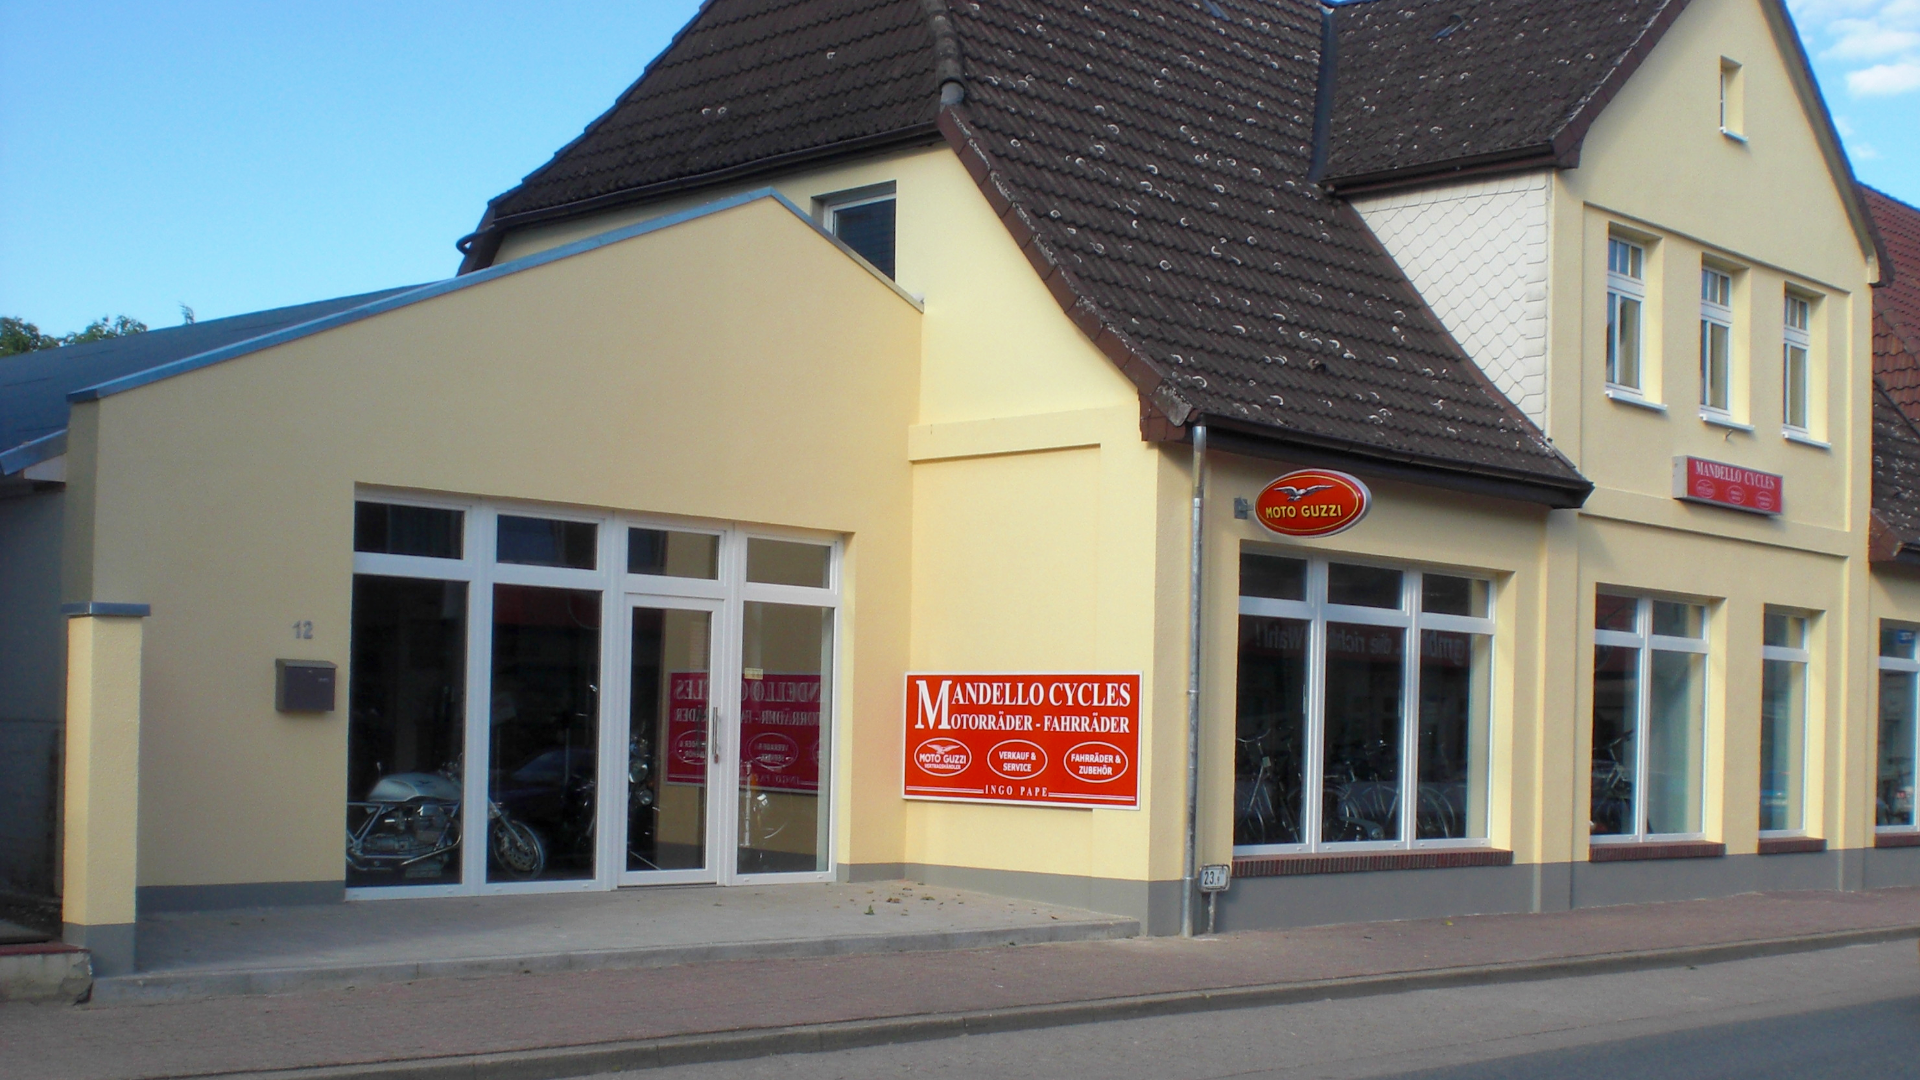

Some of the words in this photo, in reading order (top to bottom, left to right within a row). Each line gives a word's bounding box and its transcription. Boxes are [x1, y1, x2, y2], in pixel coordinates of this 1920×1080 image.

[1695, 461, 1742, 483] MANDELLO
[1744, 472, 1775, 489] CYCLES
[1265, 505, 1297, 519] MOTO
[1301, 504, 1342, 517] GUZZI
[292, 620, 313, 639] 12
[915, 680, 1045, 730] MANDELLO
[1049, 682, 1131, 707] CYCLES
[1043, 712, 1130, 733] FAHRRÄDER
[919, 753, 942, 763] MOTO
[943, 754, 967, 764] GUZZI
[999, 751, 1030, 761] VERKAUF
[1030, 751, 1037, 761] &
[1070, 752, 1114, 764] FAHRRÄDER
[1114, 755, 1122, 764] &
[1003, 763, 1032, 772] SERVICE
[1079, 765, 1113, 776] ZUBEHÖR
[985, 785, 1013, 796] INGO
[1020, 787, 1048, 798] PAPE
